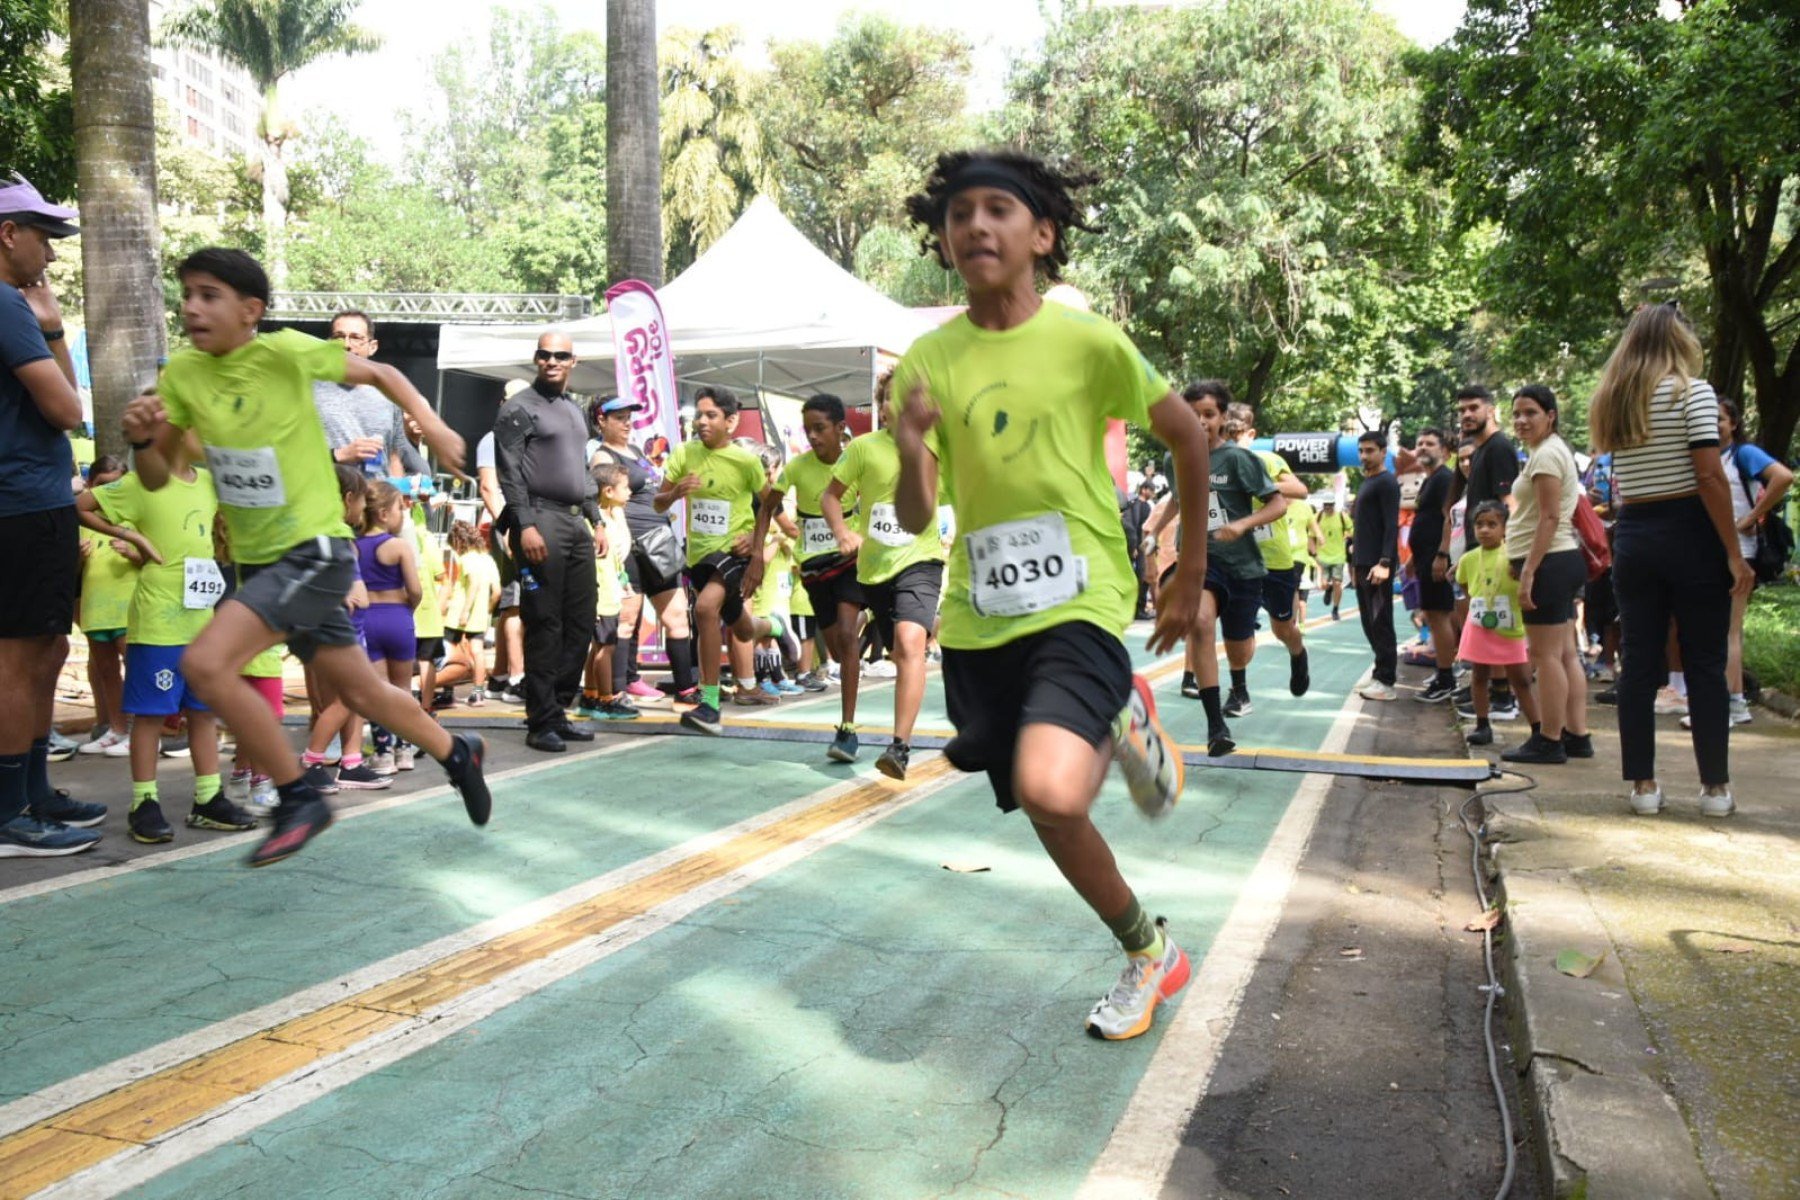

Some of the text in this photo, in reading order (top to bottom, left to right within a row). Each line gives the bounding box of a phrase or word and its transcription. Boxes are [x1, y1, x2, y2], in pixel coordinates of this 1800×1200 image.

[1274, 438, 1329, 452] POWER
[1299, 450, 1330, 463] ADE
[221, 473, 275, 490] 4049
[693, 513, 726, 525] 4012
[810, 533, 835, 543] 400
[984, 554, 1064, 591] 4030
[188, 580, 223, 595] 4191
